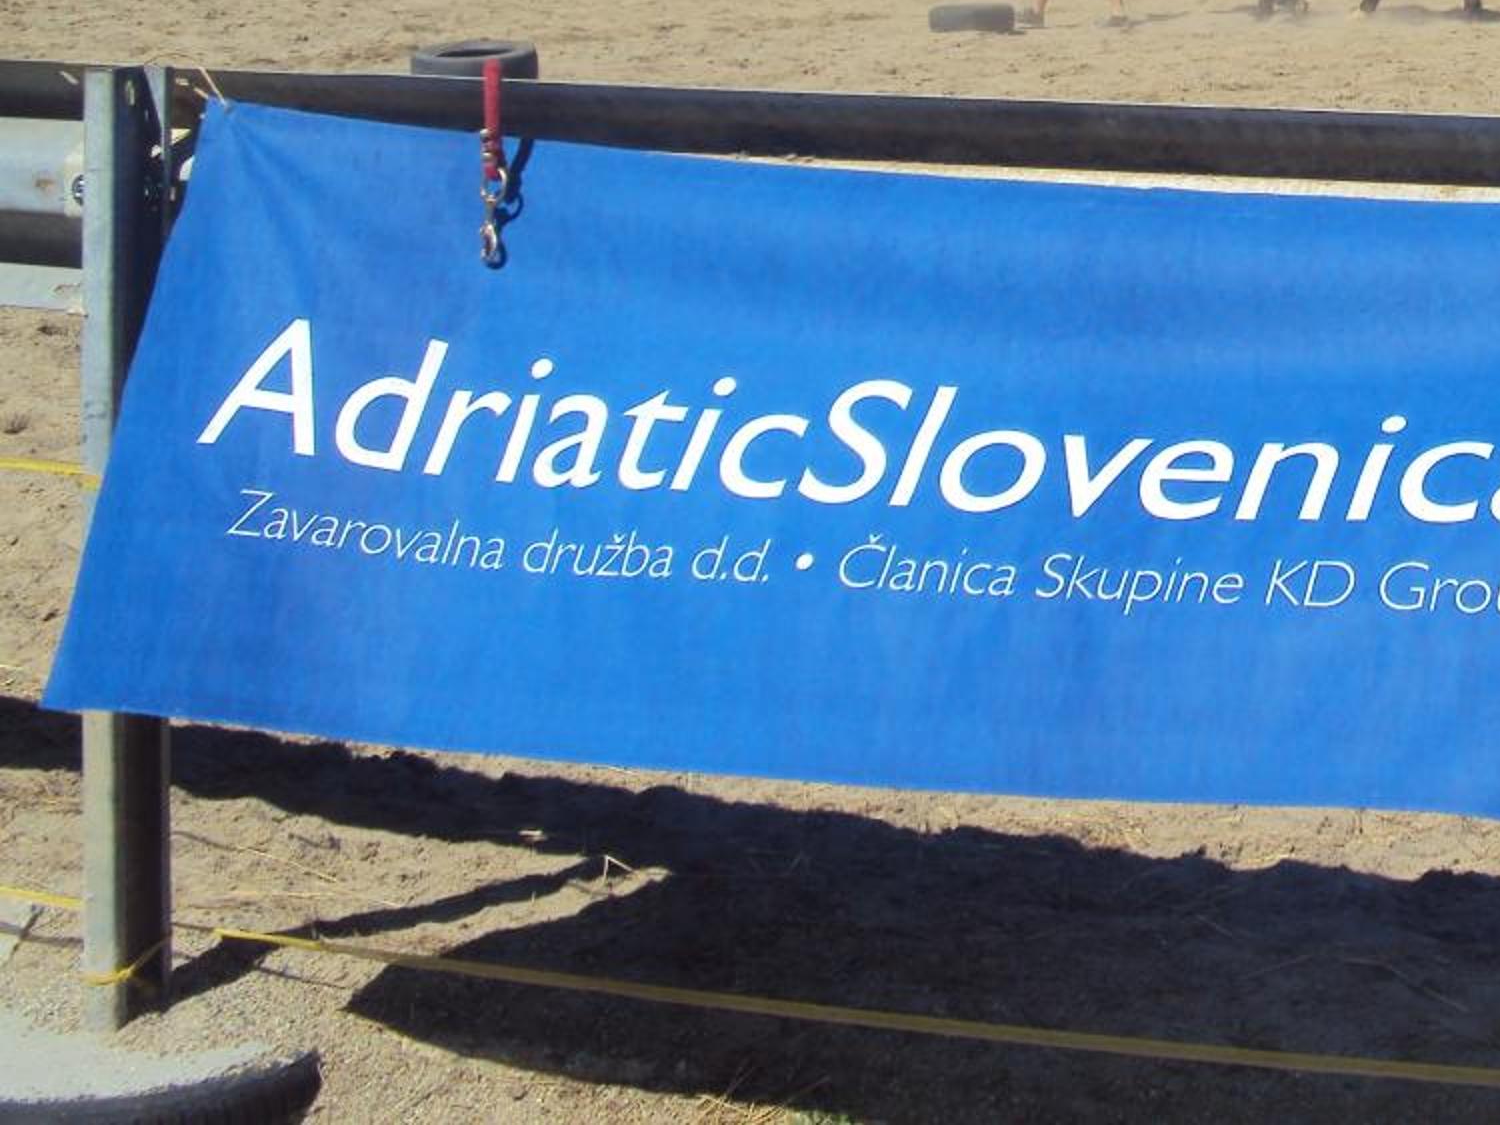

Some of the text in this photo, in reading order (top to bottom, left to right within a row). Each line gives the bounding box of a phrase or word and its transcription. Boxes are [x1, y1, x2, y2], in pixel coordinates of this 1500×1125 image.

[225, 488, 504, 571] Zavarovalna
[521, 528, 673, 579] družba
[691, 535, 773, 583] d.d.
[837, 533, 1017, 597] Članica
[1034, 552, 1244, 616] Skupine
[1265, 559, 1356, 608] KD
